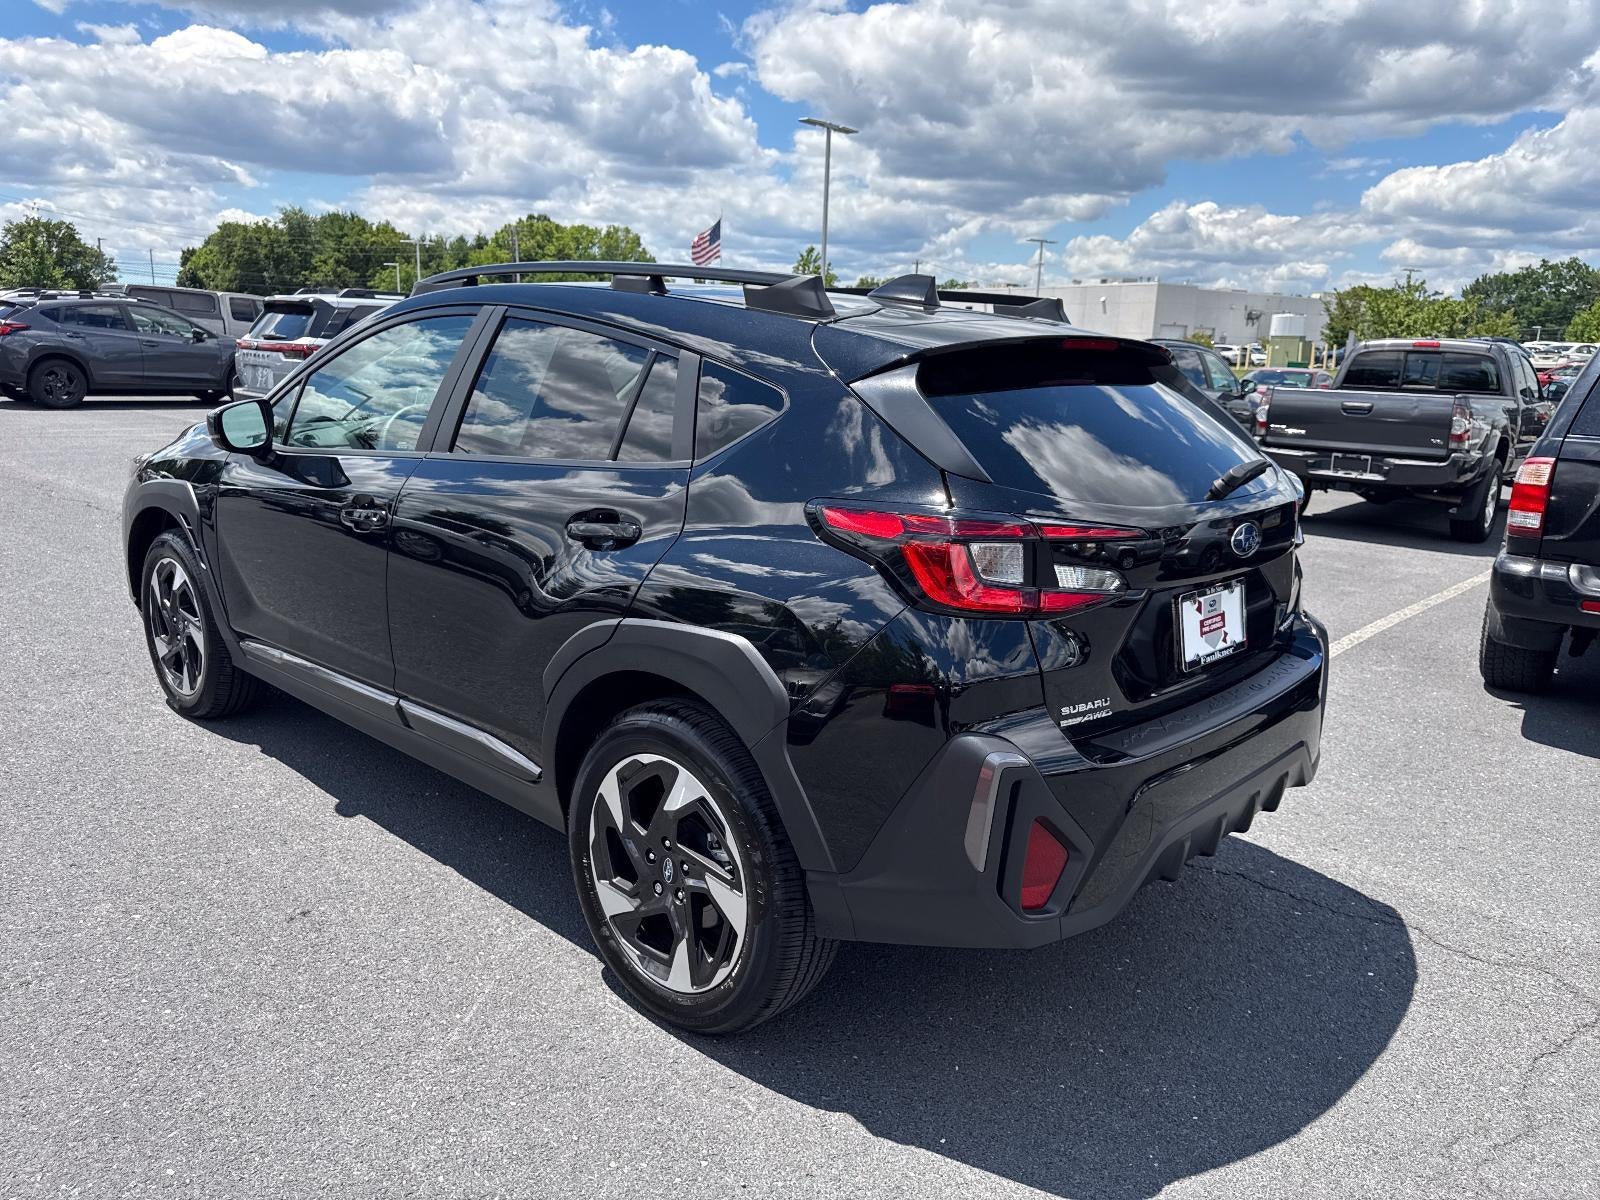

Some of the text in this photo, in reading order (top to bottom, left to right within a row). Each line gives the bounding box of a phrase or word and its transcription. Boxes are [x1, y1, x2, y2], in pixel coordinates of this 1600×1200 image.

[1202, 620, 1224, 633] PRE-OWNED
[1203, 615, 1222, 626] CERTIFIED
[1200, 646, 1235, 665] Faulkner
[1060, 697, 1111, 716] SUBARU
[1081, 708, 1113, 723] AWD
